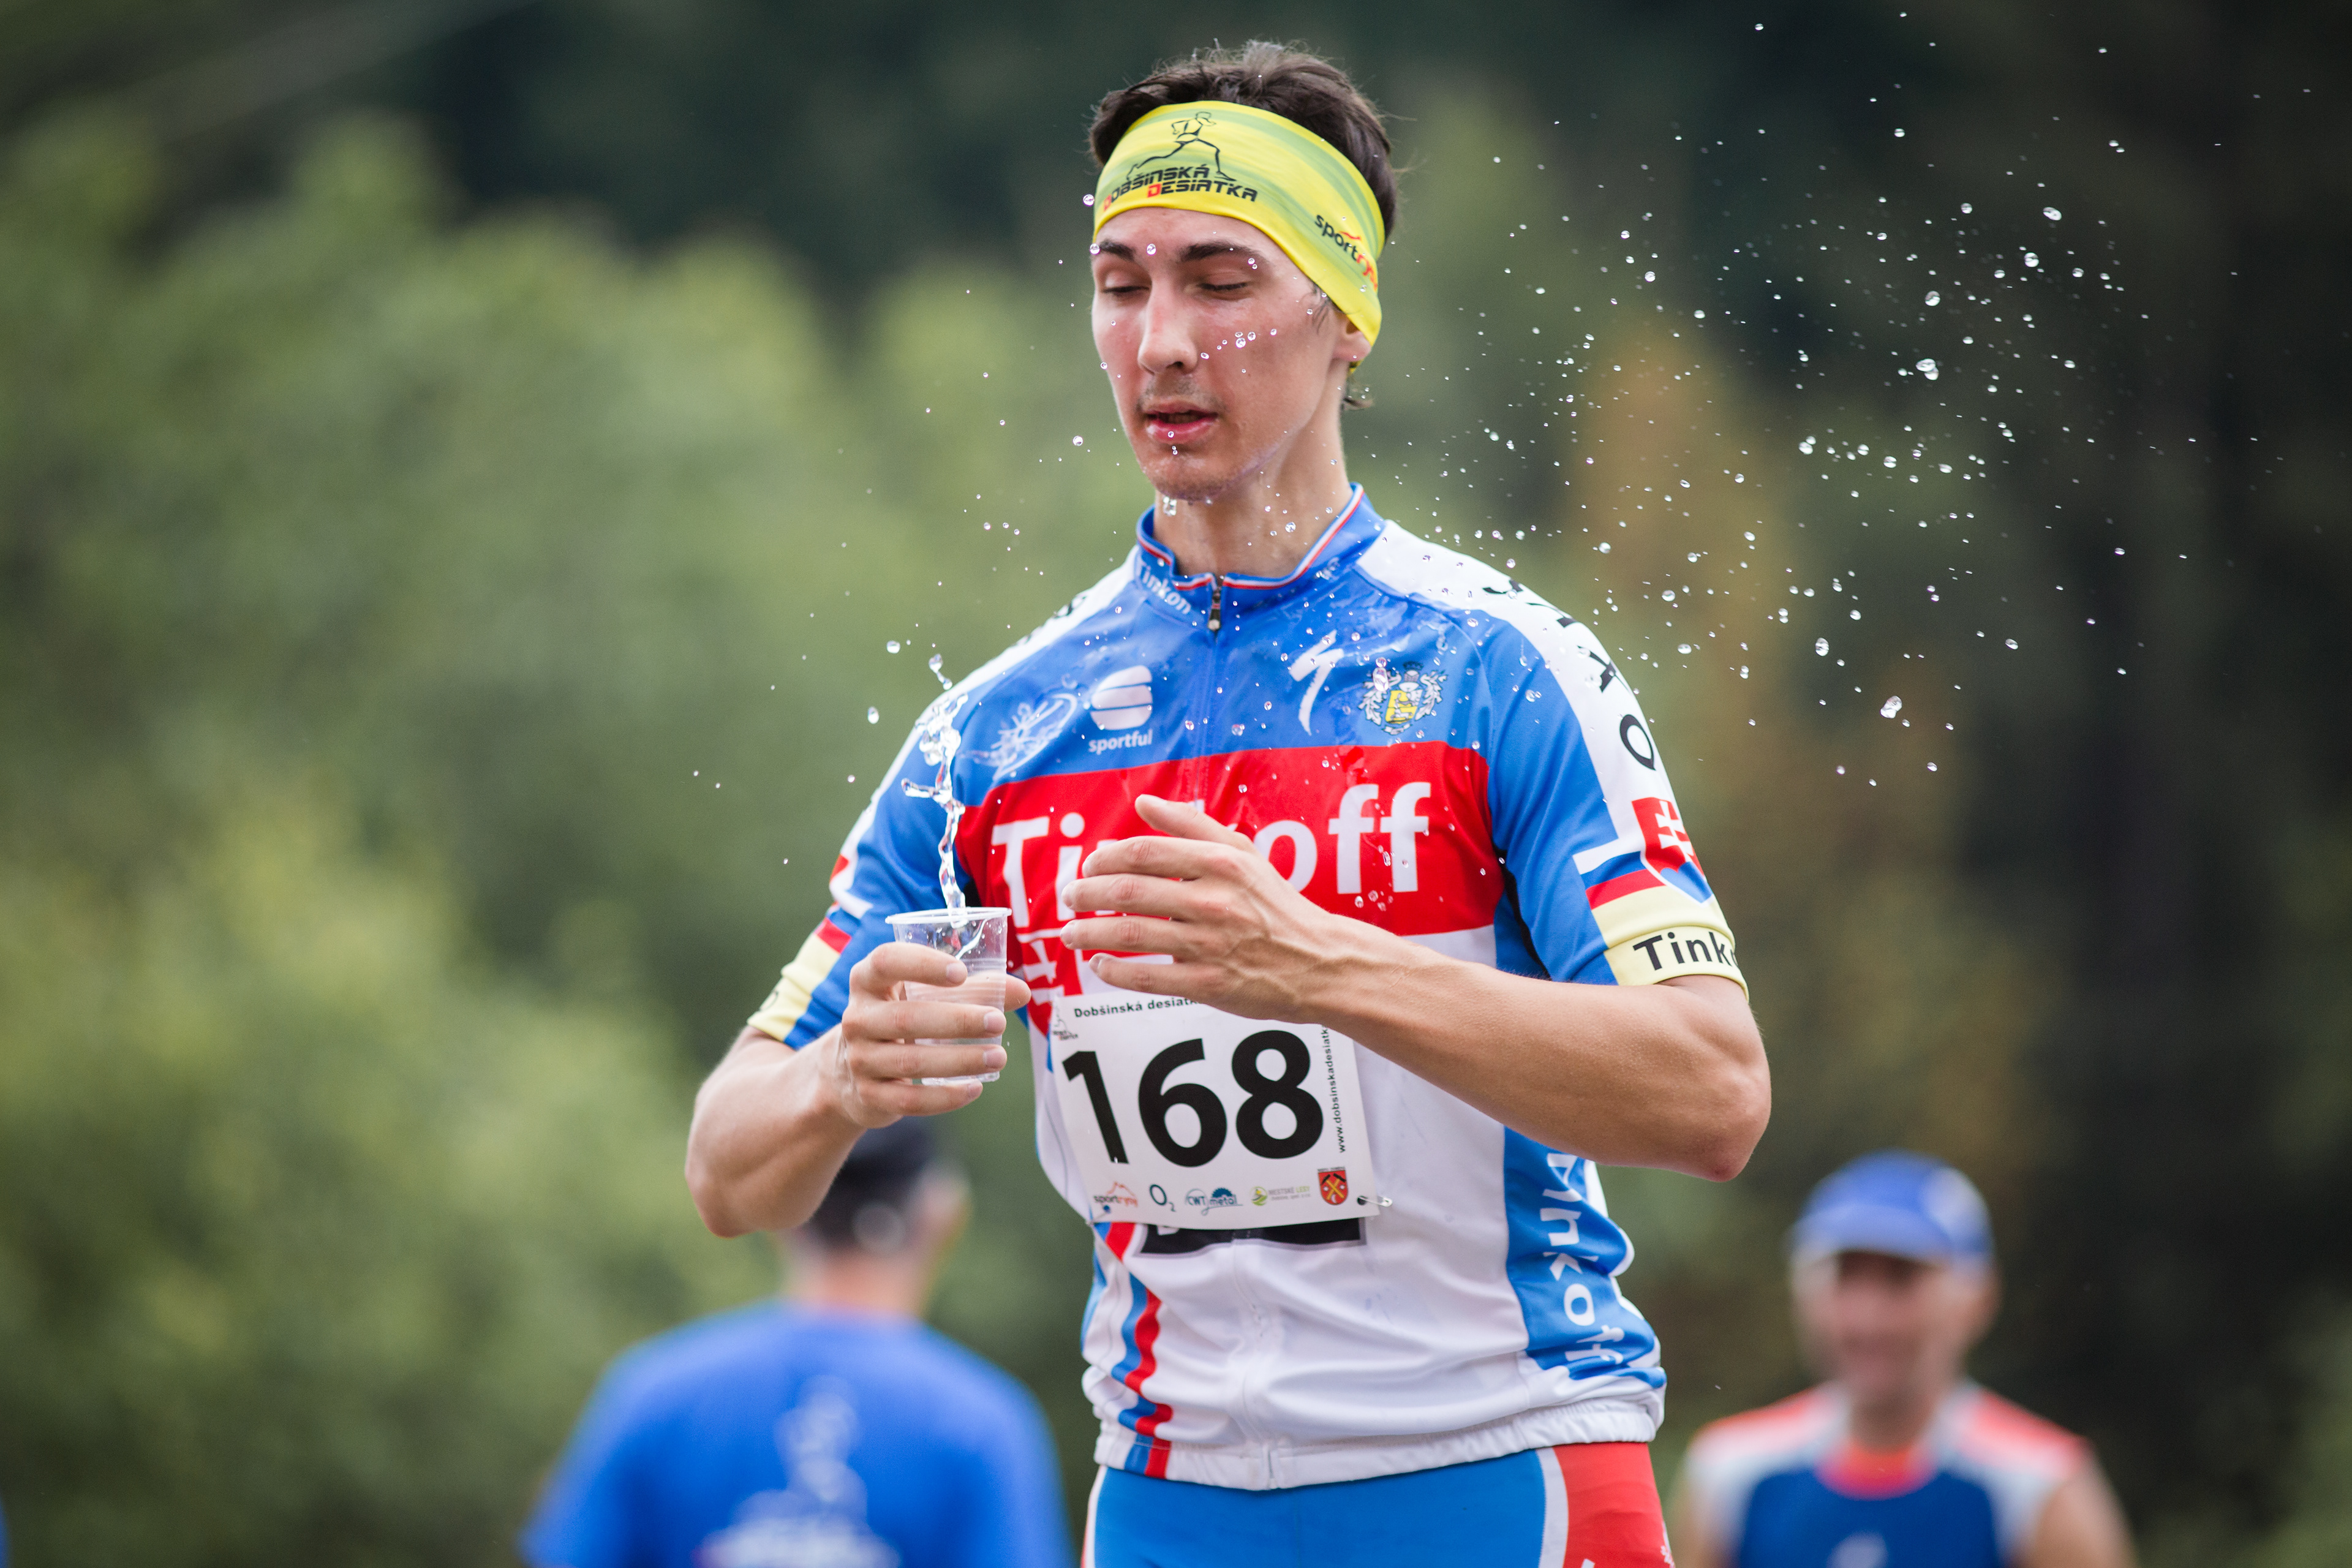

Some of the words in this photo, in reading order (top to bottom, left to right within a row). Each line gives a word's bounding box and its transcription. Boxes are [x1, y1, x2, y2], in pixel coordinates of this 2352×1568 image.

[1088, 729, 1153, 755] sportful
[991, 782, 1431, 929] Tioff
[1074, 1001, 1143, 1018] Dobšinská
[1061, 1029, 1324, 1168] 168
